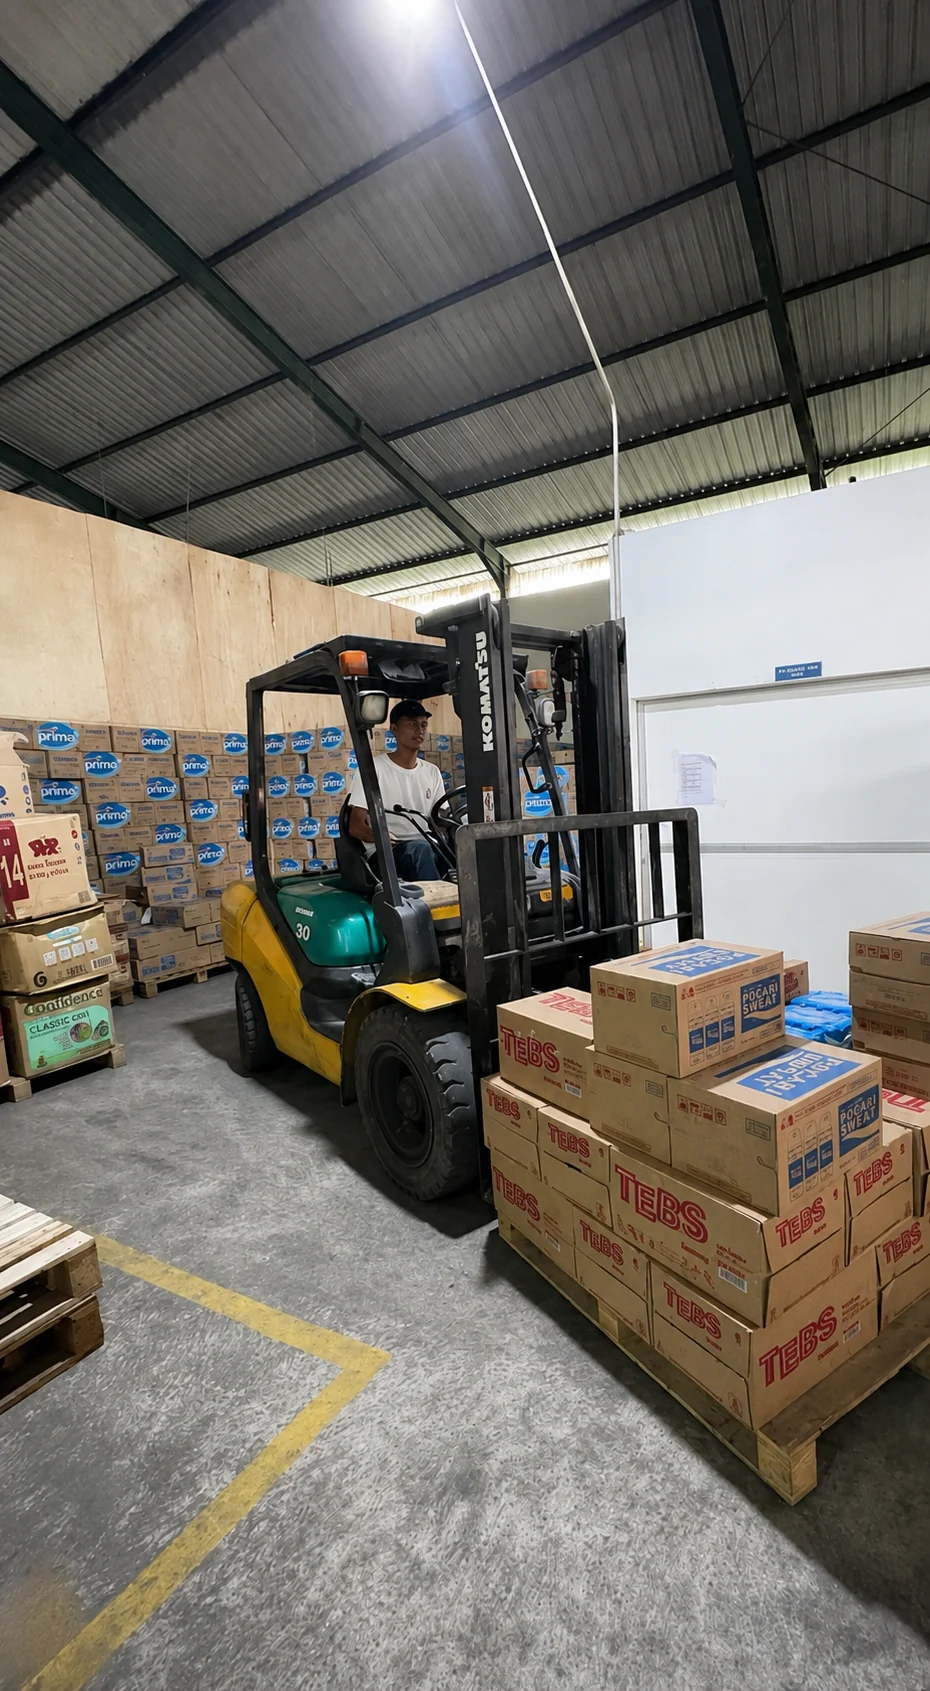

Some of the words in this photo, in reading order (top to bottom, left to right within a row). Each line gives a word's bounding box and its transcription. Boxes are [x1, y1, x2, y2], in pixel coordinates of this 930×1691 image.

[475, 631, 494, 752] KOMATSU
[38, 731, 76, 745] prima
[1, 854, 24, 888] 14
[296, 923, 310, 941] 30
[24, 988, 103, 1016] Confidence
[742, 982, 778, 1004] POCARI
[743, 994, 777, 1015] SWEAT
[500, 1024, 560, 1073] TEBS
[486, 1088, 521, 1121] TEBS
[840, 1094, 876, 1124] POCARI
[840, 1106, 875, 1137] SWEAT
[548, 1122, 590, 1158] TEBS
[493, 1165, 541, 1221] TEBS
[853, 1151, 893, 1196] TEBS
[614, 1163, 708, 1243] TEBS
[776, 1197, 826, 1248] TEBS
[580, 1219, 624, 1266] TEBS
[882, 1221, 922, 1264] TEBS
[663, 1281, 722, 1339] TEBS
[759, 1305, 838, 1388] TEBS
